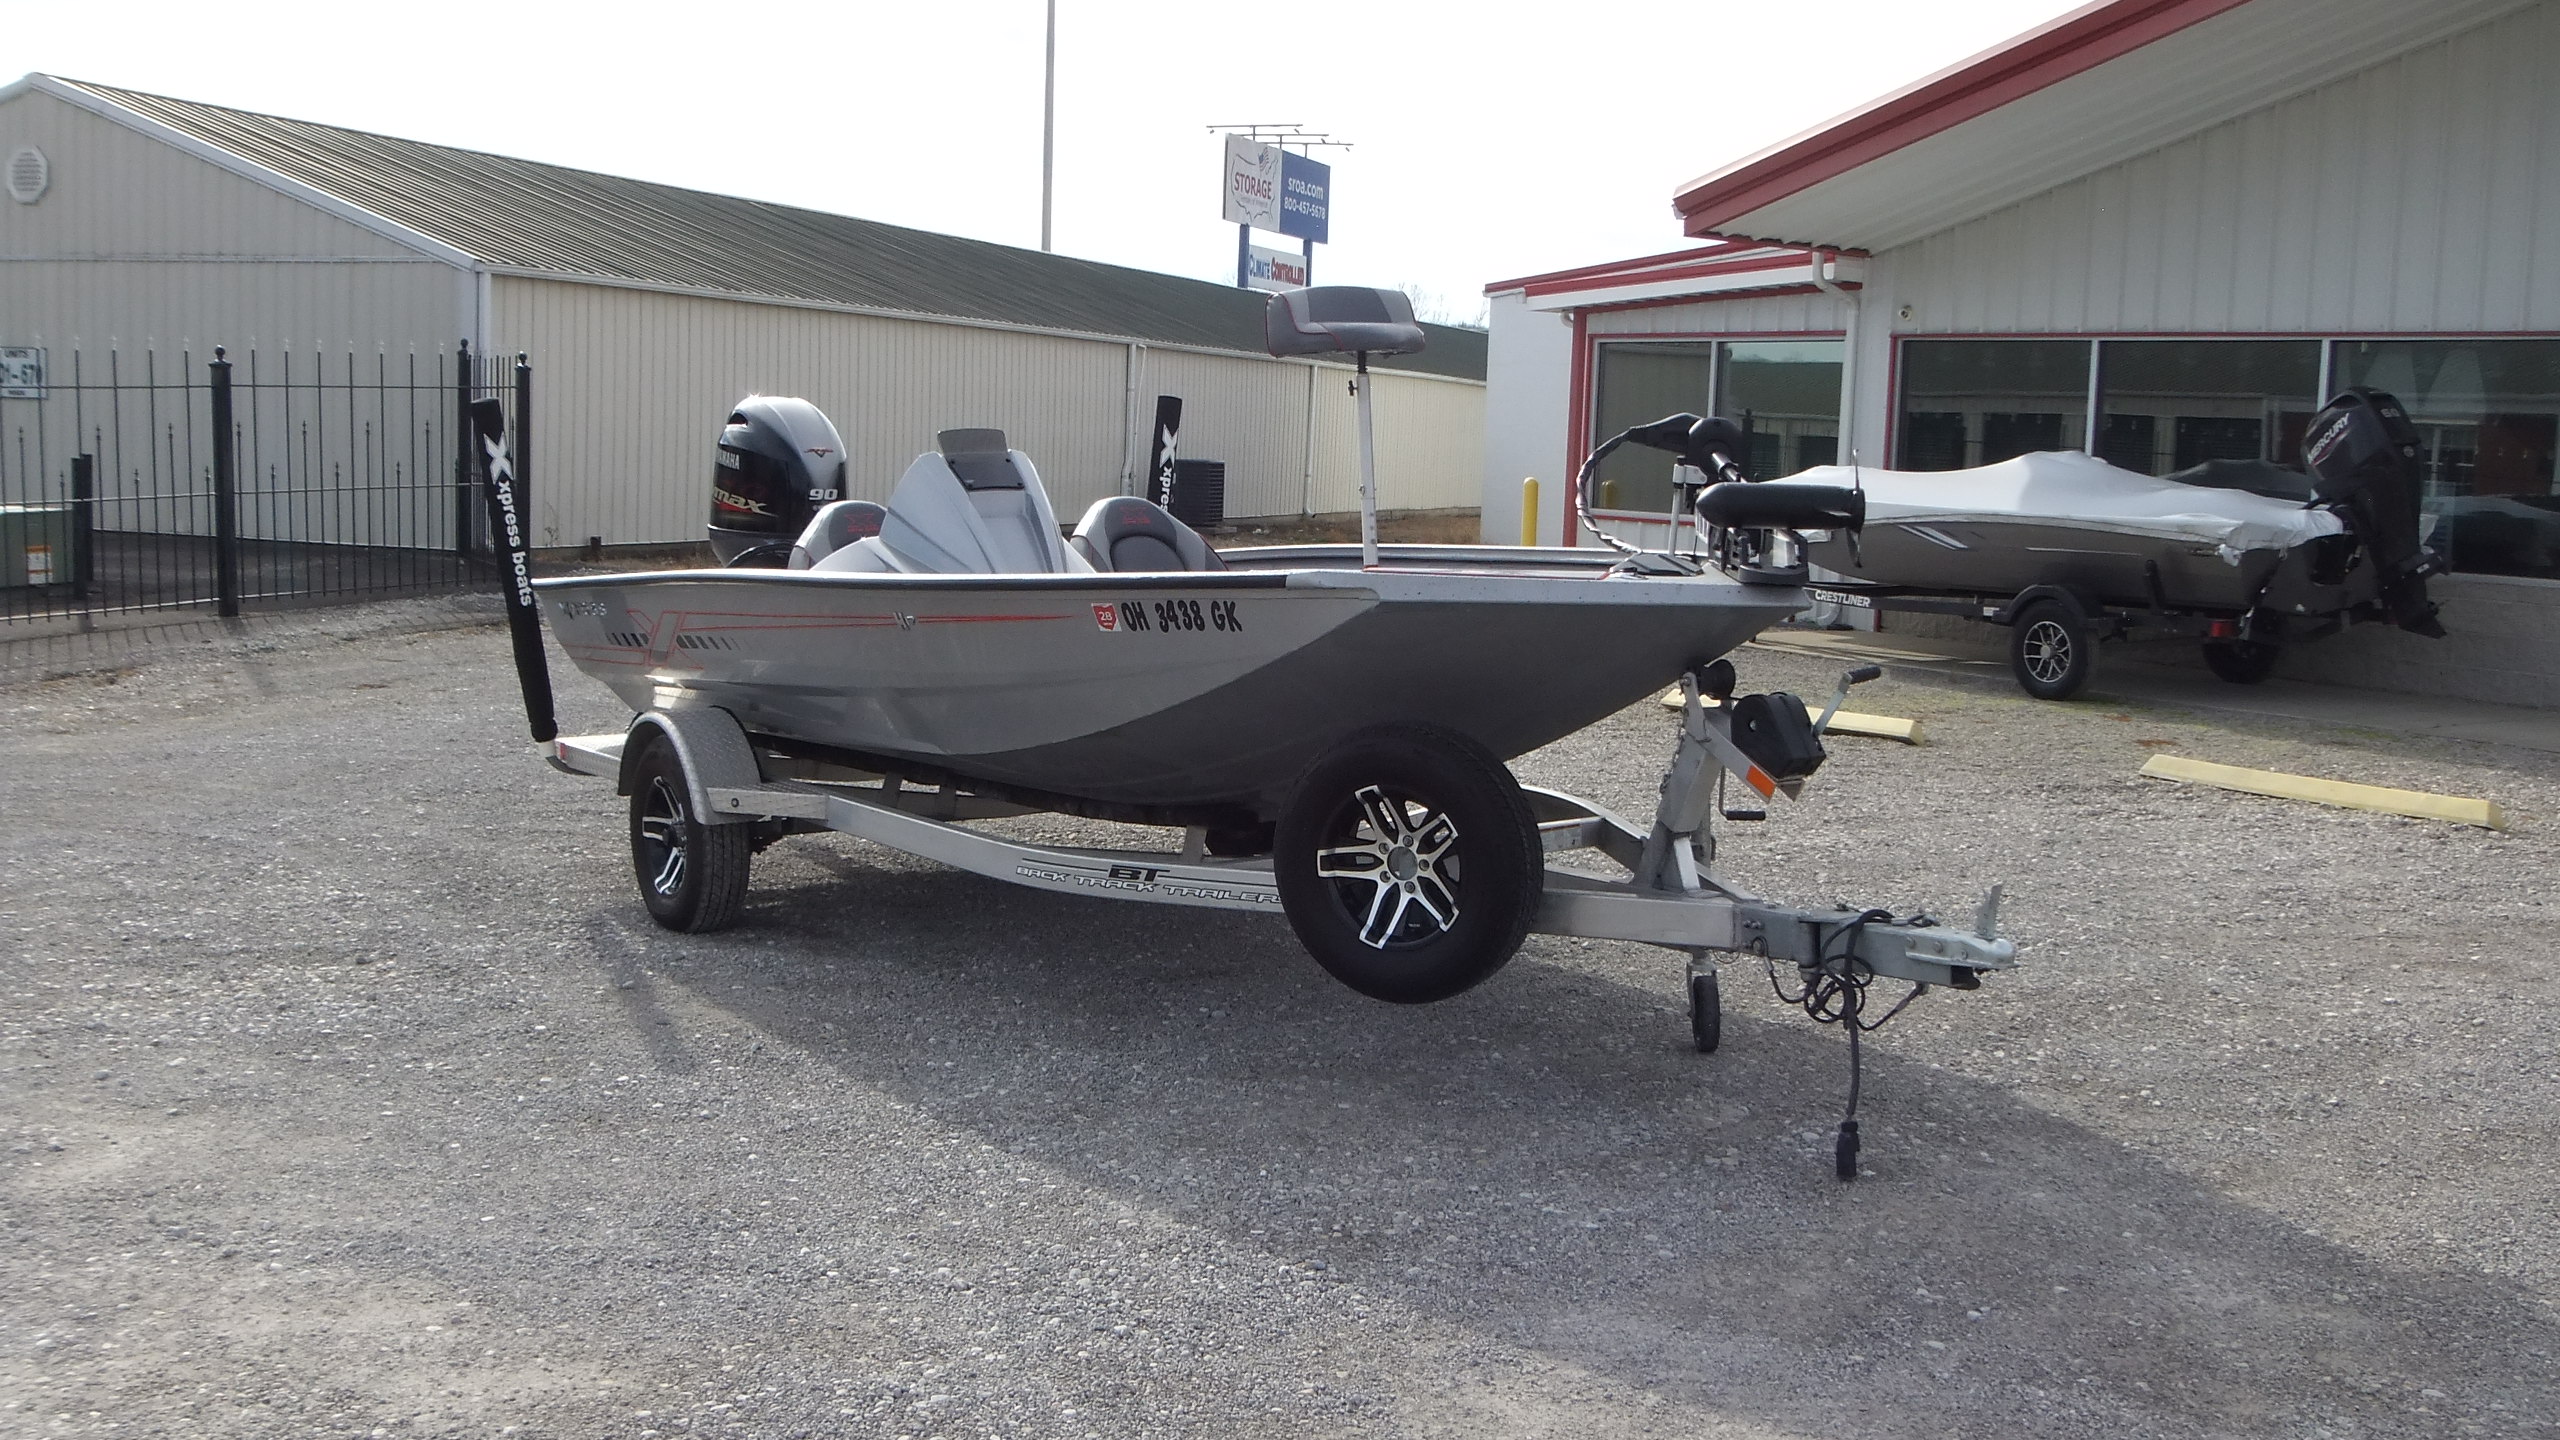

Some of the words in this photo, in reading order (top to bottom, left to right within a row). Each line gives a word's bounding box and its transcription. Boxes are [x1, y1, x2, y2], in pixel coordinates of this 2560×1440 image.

[1234, 171, 1272, 200] STORAGE
[1287, 177, 1324, 200] sroa.com
[1284, 196, 1326, 220] 800-457-5678
[2307, 412, 2350, 465] MERCURY
[808, 488, 839, 501] 90
[1160, 466, 1173, 513] xpres
[497, 480, 521, 549] xpress
[511, 551, 533, 608] boats
[1814, 589, 1871, 608] CRESTLINER
[1120, 601, 1151, 632] OH
[1154, 600, 1205, 633] 3438
[1210, 600, 1243, 633] GK
[1015, 865, 1071, 882] BACK
[1073, 875, 1160, 893] TRACK
[1162, 884, 1282, 905] TRAILER
[1107, 864, 1171, 883] BT
